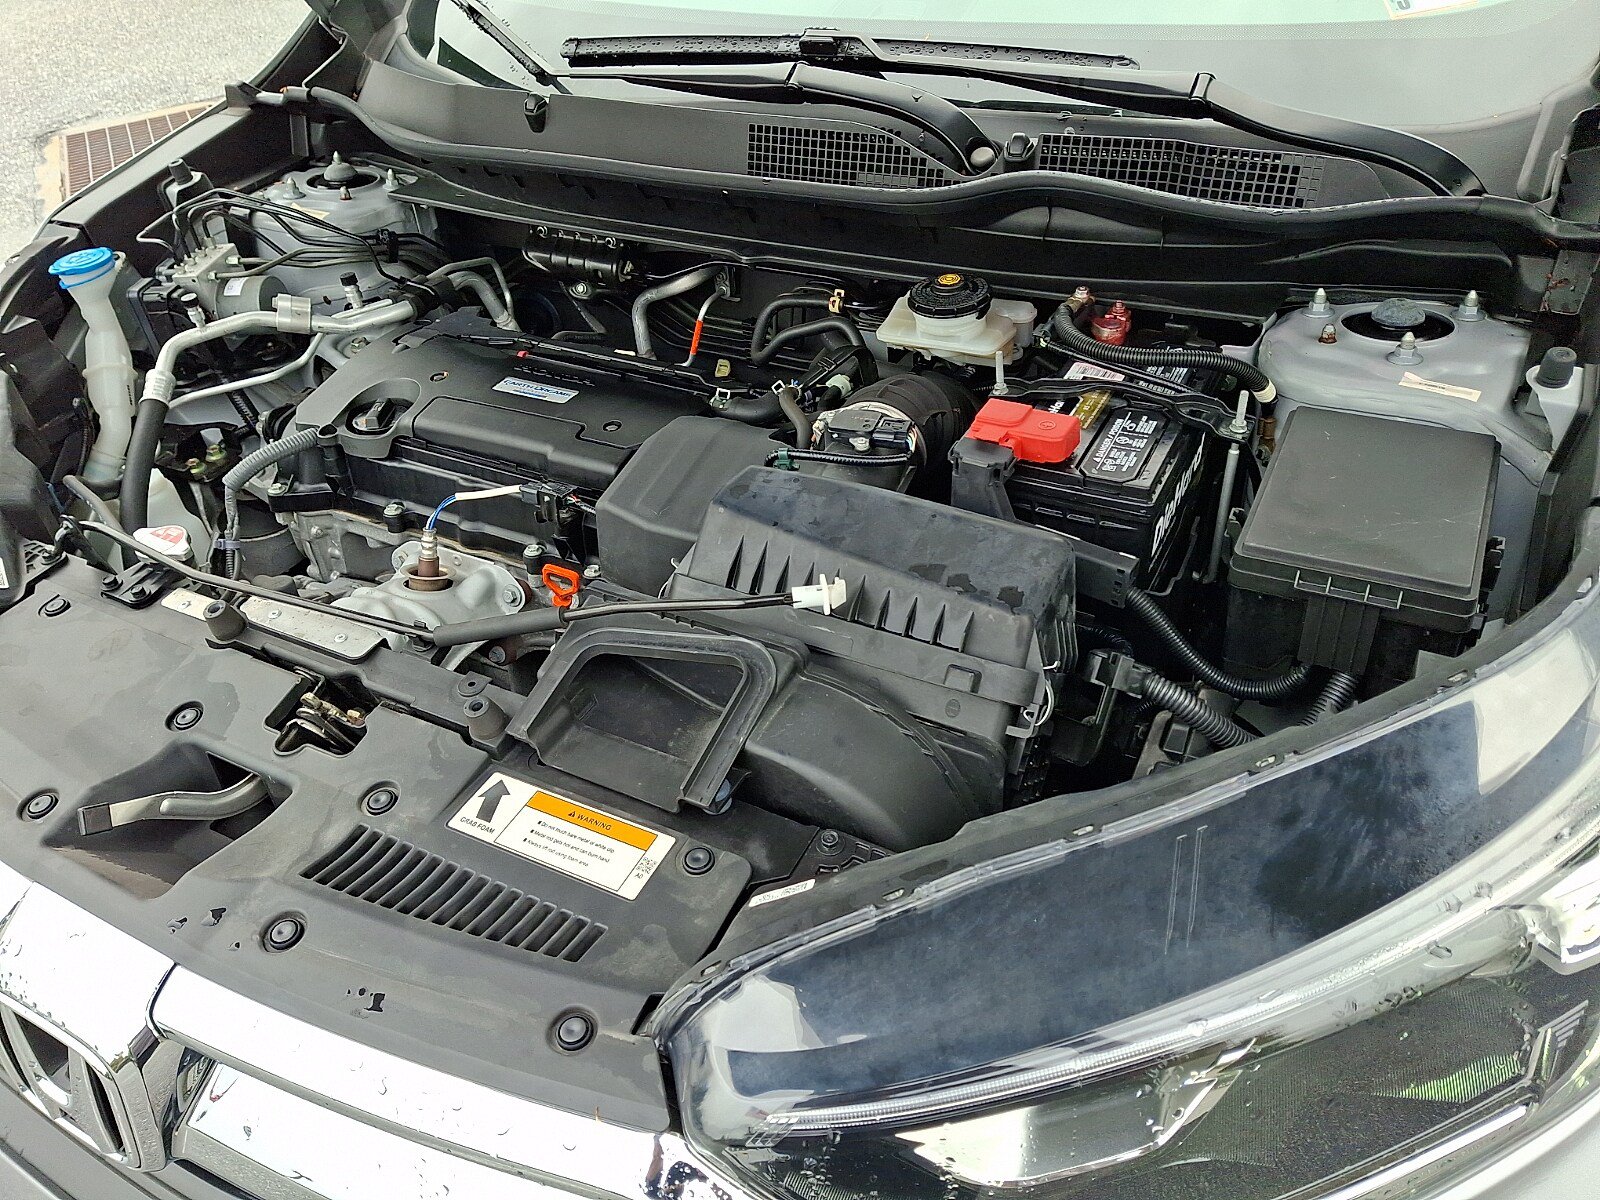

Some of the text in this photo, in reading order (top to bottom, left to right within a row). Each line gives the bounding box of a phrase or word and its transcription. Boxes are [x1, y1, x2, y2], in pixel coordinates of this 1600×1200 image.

[1151, 432, 1206, 558] DieHard
[460, 816, 496, 835] GRAB FOAM
[577, 813, 612, 831] WARNING
